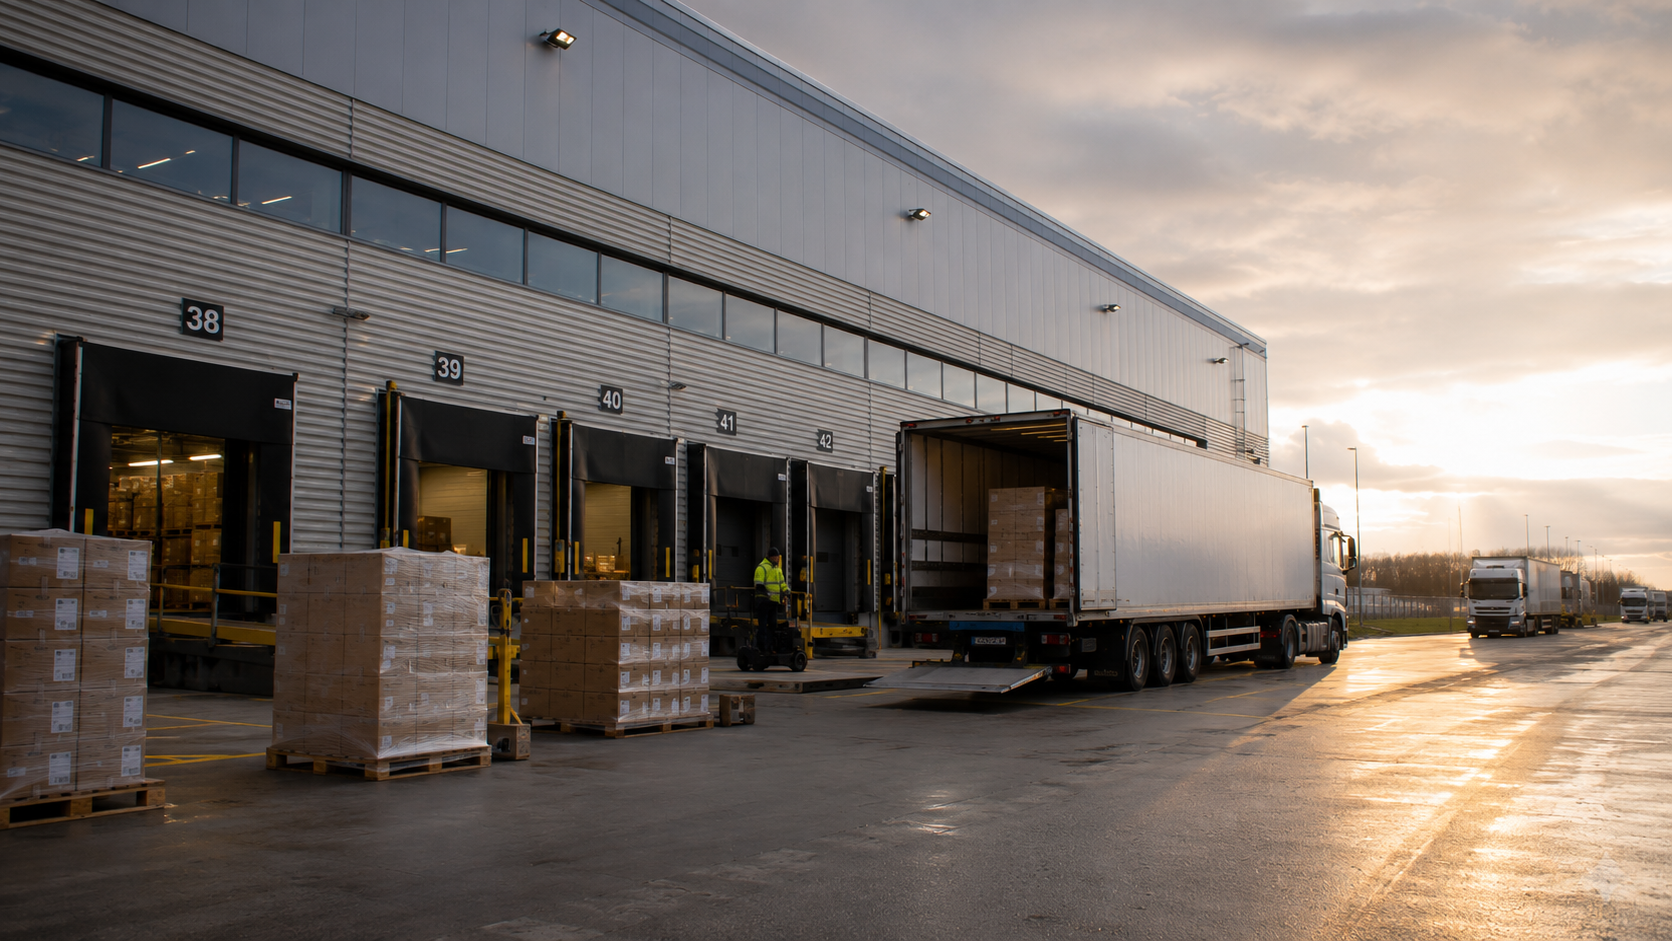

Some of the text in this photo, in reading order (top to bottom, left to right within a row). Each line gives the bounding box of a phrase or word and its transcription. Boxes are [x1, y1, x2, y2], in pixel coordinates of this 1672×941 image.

[186, 305, 221, 334] 38
[437, 356, 462, 380] 39
[602, 390, 622, 410] 40
[720, 414, 734, 431] 41
[819, 434, 832, 449] 42
